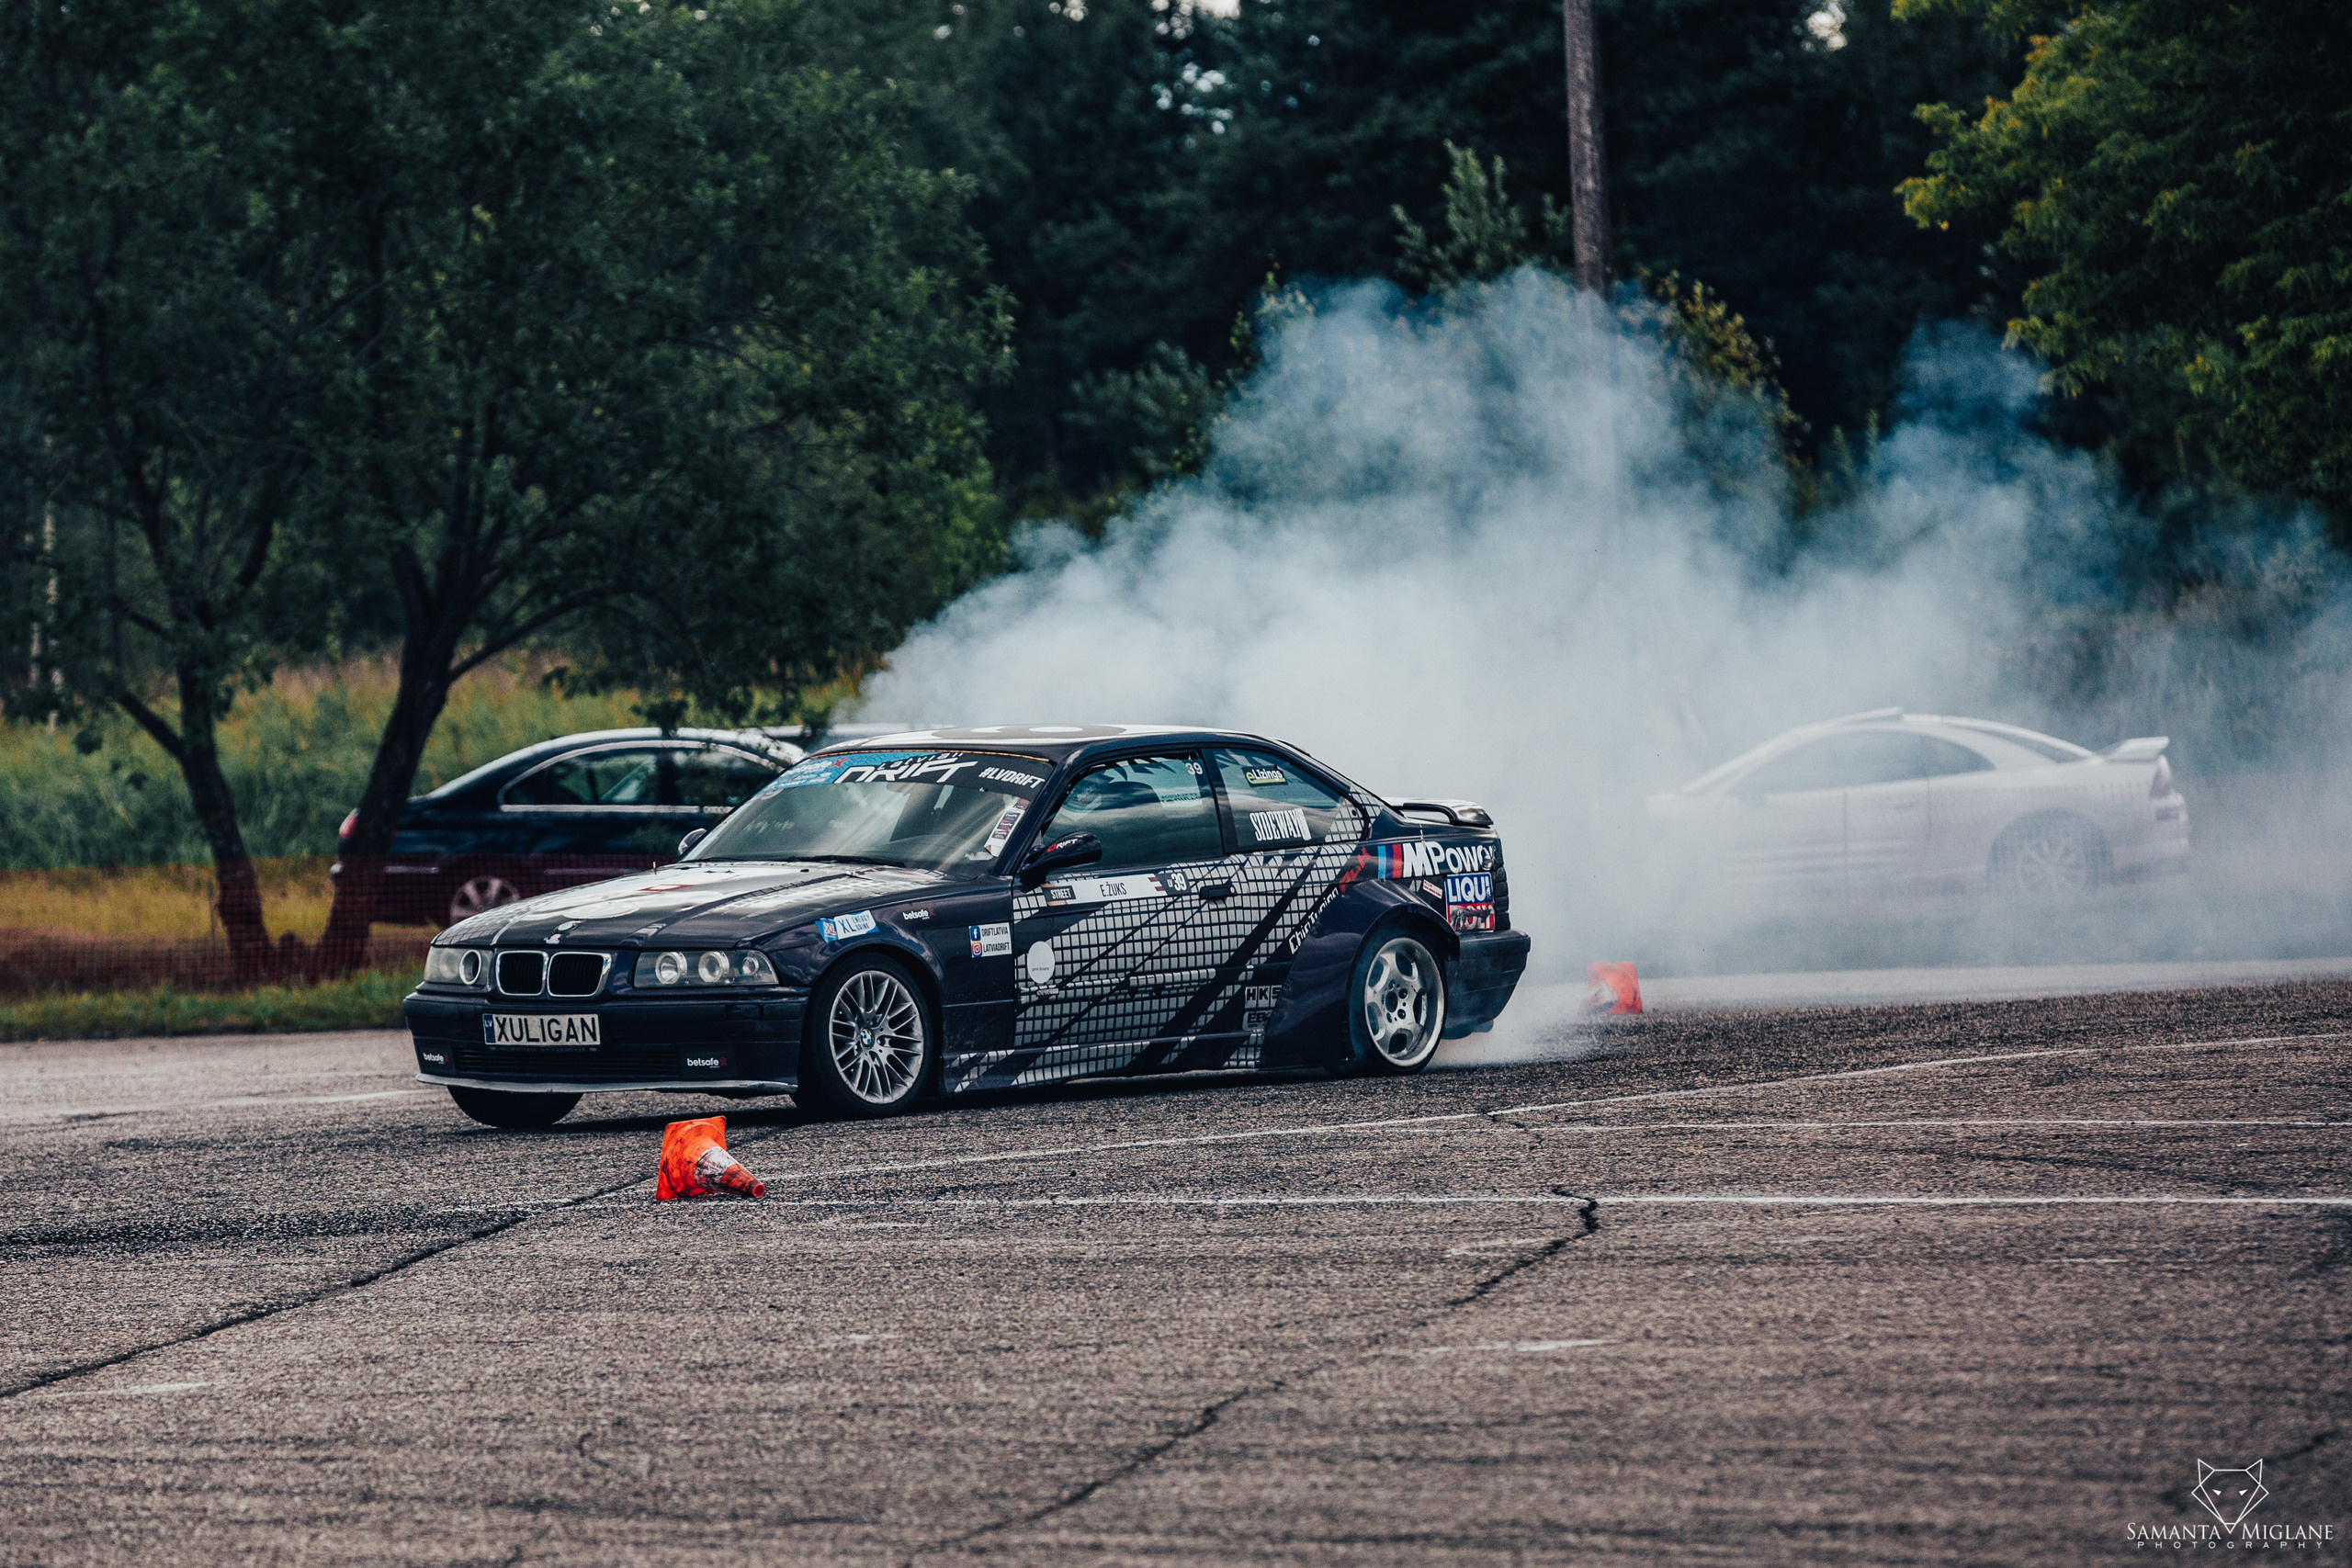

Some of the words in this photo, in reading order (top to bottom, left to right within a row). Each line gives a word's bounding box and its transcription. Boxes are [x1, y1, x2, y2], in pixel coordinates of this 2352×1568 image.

[1184, 761, 1204, 775] 39
[978, 766, 1046, 789] #LVDRIFT
[1046, 838, 1079, 852] DRIFT
[1050, 887, 1071, 900] STREET
[1099, 881, 1127, 897] E.ŽUKS
[1170, 873, 1187, 891] 39
[1447, 876, 1491, 903] LIQUI
[903, 908, 929, 920] betsafe
[837, 917, 856, 933] XL
[981, 926, 1009, 937] DRIFTLATVIA
[983, 942, 1010, 953] LATVIADRIFT
[495, 1017, 597, 1043] XULIGAN
[686, 1057, 719, 1066] betsafe
